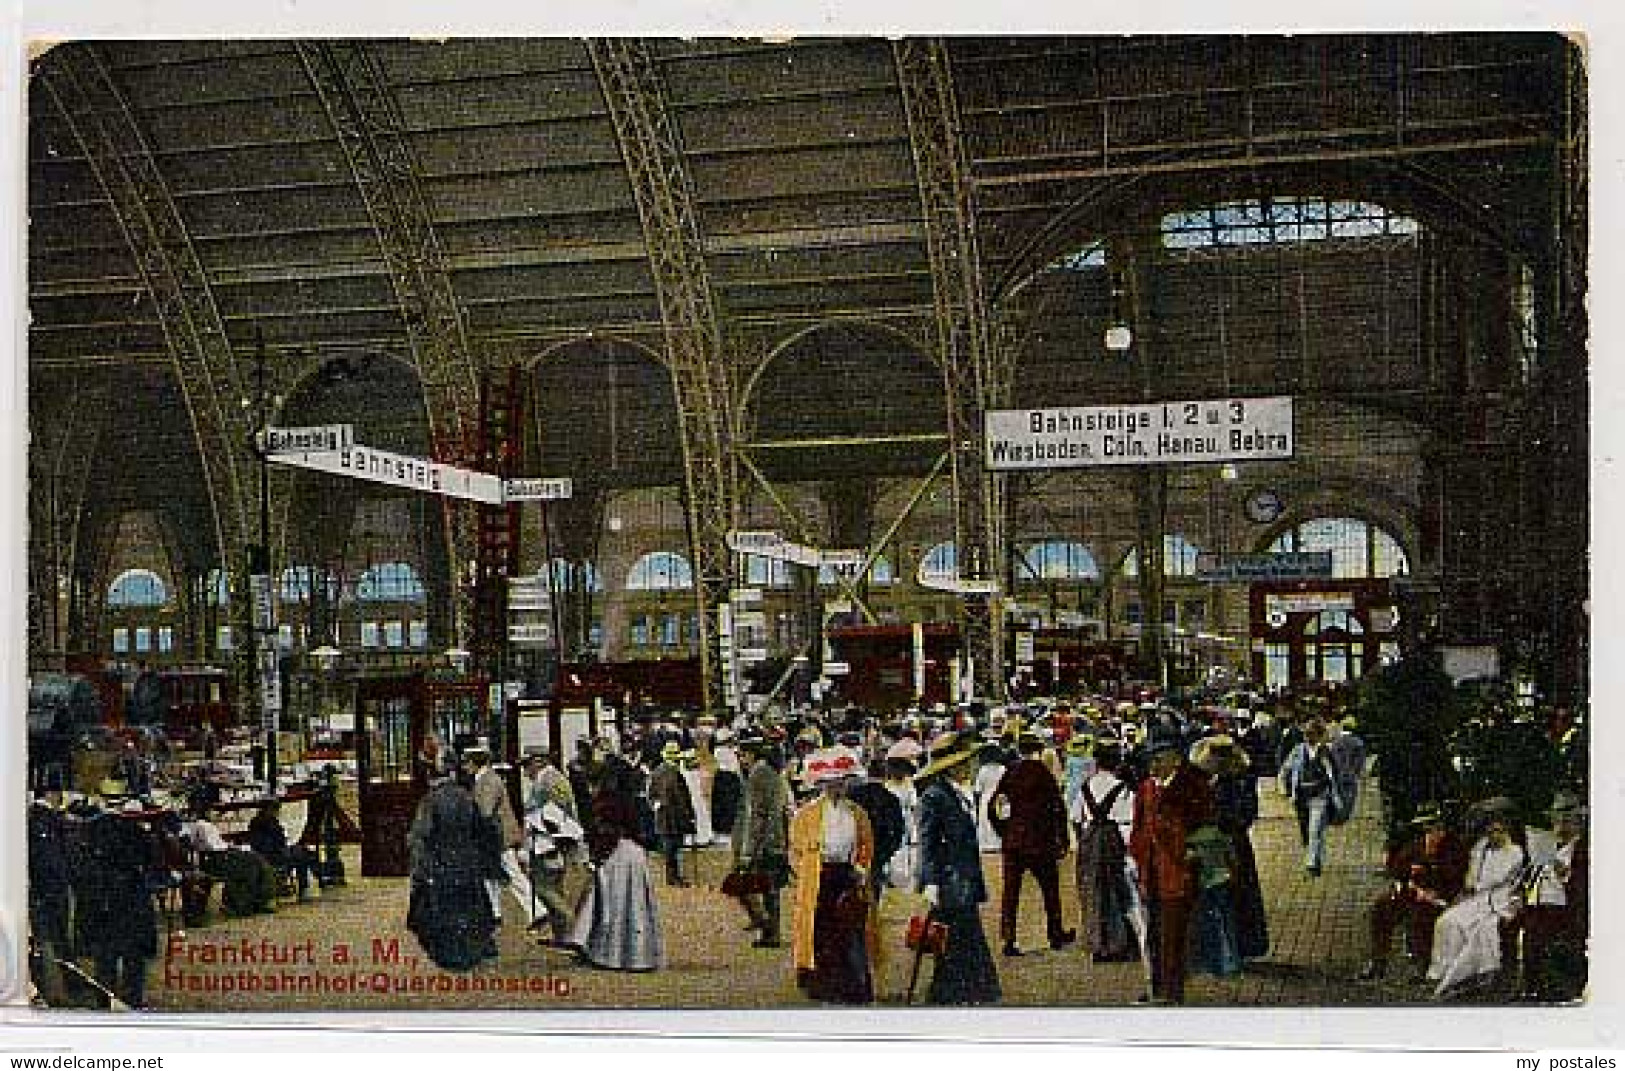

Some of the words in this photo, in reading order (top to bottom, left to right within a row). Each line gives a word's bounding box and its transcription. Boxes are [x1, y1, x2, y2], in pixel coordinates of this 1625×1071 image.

[1029, 411, 1151, 433] Bahnsteige
[1183, 403, 1199, 425] 2
[1229, 429, 1287, 452] Bebra
